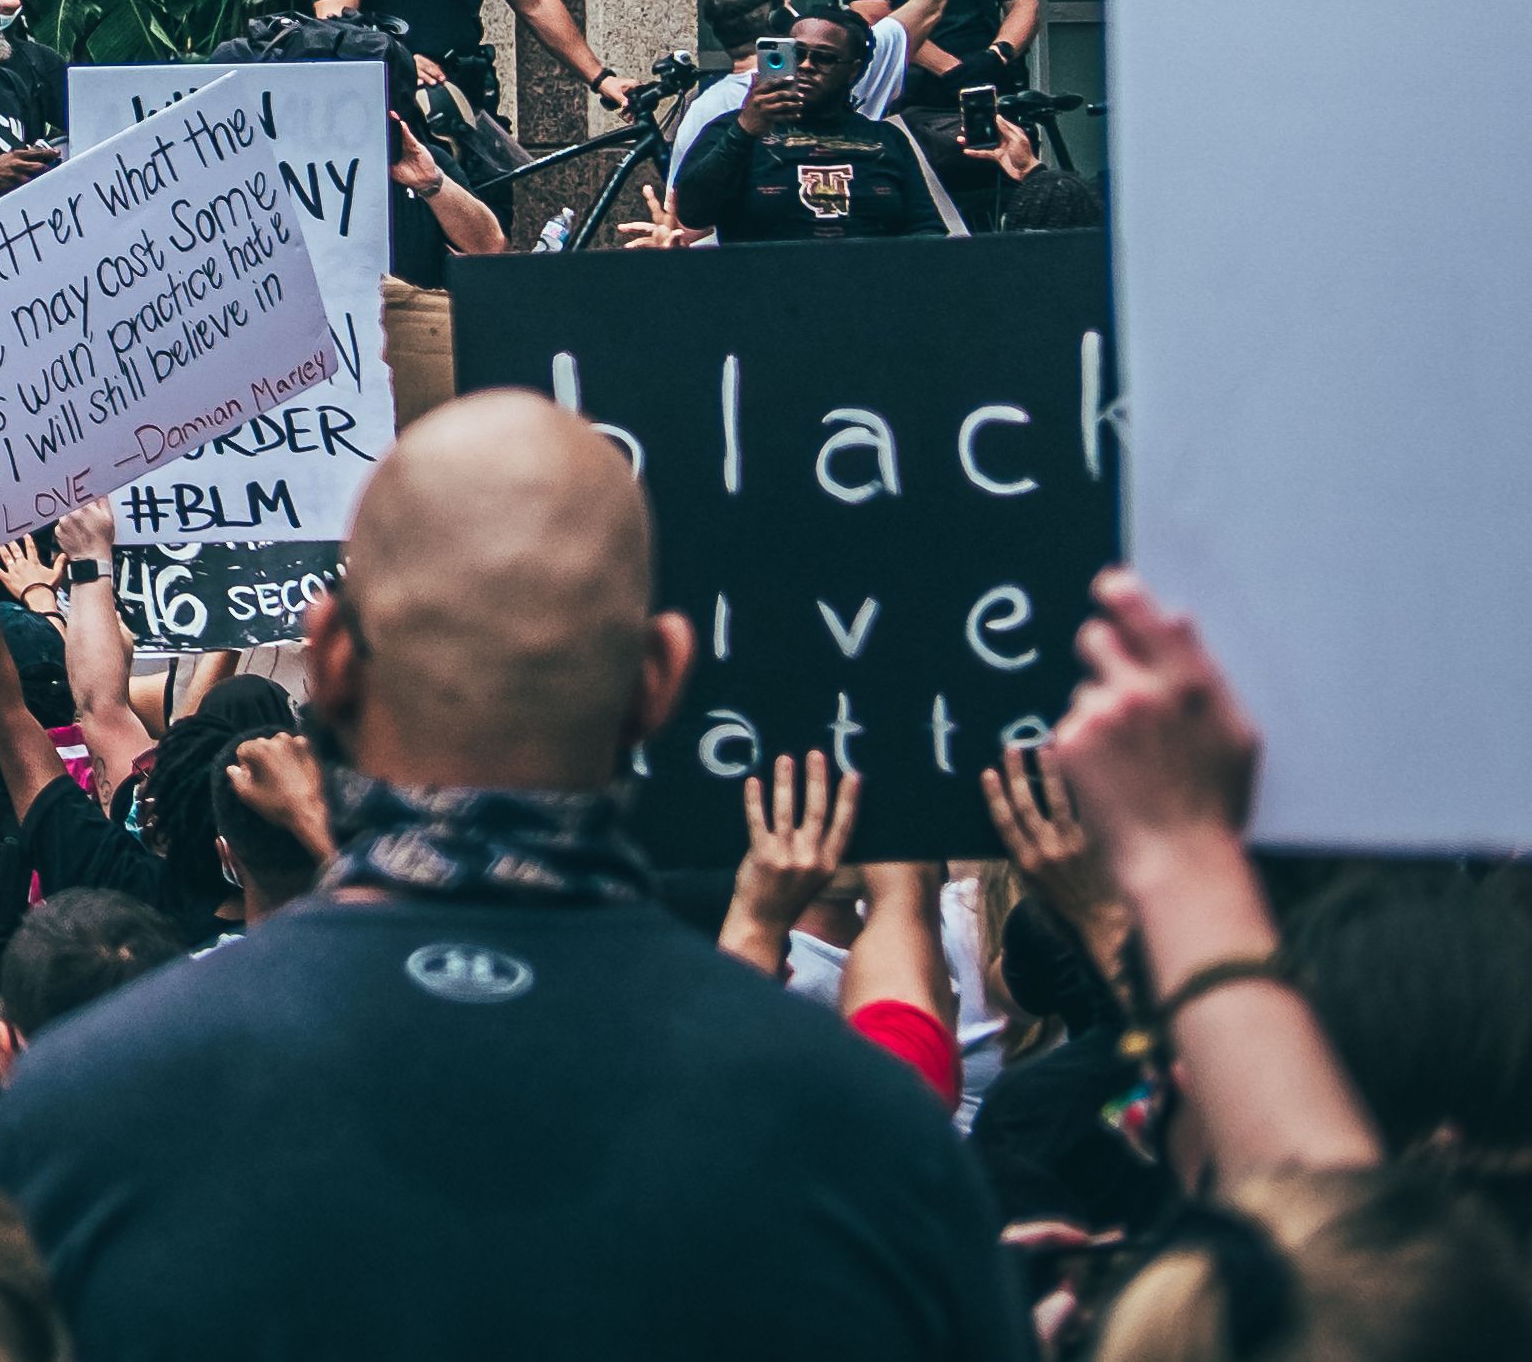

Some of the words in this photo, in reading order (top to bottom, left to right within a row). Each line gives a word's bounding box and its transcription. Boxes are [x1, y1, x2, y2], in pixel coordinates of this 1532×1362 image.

[183, 108, 255, 169] the
[11, 275, 89, 347] may
[108, 256, 223, 376] practice
[223, 211, 291, 281] hate
[3, 437, 21, 483] I
[88, 356, 146, 425] still
[146, 299, 248, 384] believe
[252, 272, 283, 313] in
[2, 468, 95, 536] LOVE
[251, 350, 327, 404] Marley
[121, 478, 302, 535] #BLM
[117, 555, 209, 640] 46
